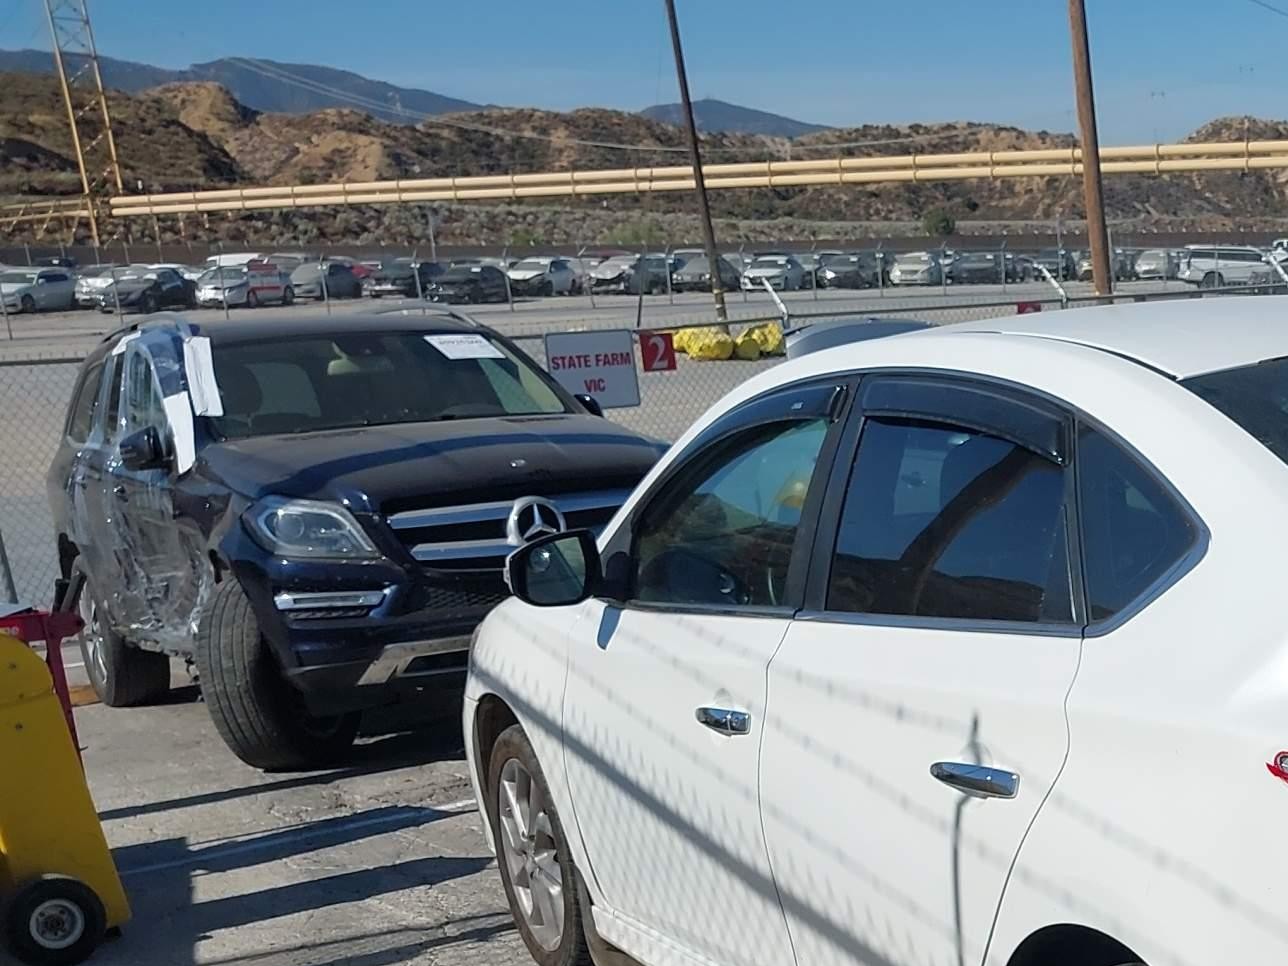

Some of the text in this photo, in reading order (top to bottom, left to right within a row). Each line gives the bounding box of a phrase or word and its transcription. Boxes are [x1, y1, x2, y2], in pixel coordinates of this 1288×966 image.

[551, 352, 632, 371] STATE FARM
[648, 335, 669, 370] 2
[583, 379, 606, 394] VIC
